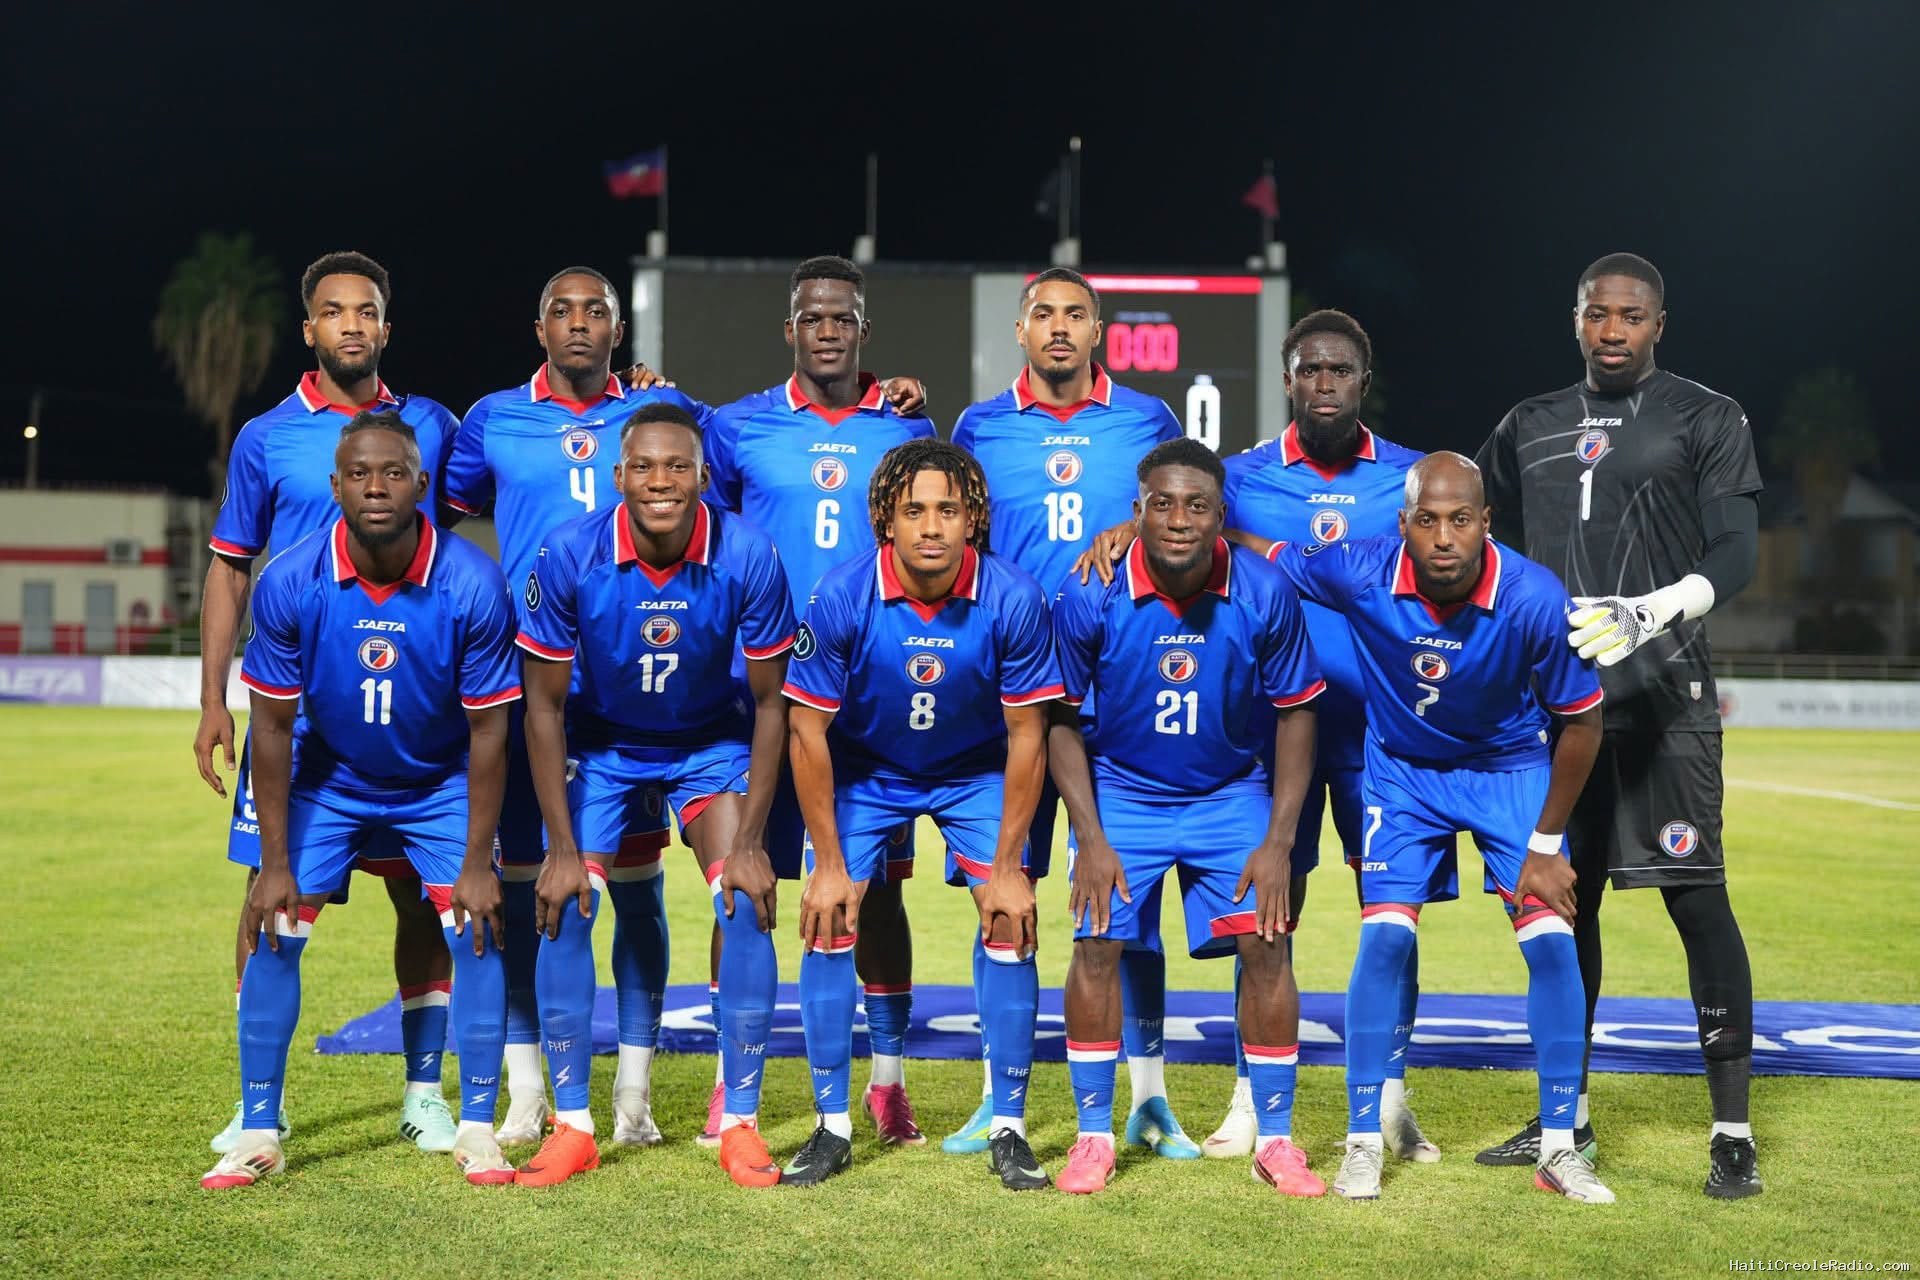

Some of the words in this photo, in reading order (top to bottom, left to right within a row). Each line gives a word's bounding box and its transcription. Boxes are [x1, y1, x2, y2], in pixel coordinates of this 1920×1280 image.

[1576, 418, 1623, 427] SAETA
[1040, 436, 1090, 446] SAETA
[808, 443, 857, 454] SAETA
[569, 467, 596, 512] 4
[1579, 469, 1593, 520] 1
[1305, 494, 1356, 504] SAETA
[1043, 492, 1083, 542] 18
[815, 498, 840, 549] 6
[635, 600, 688, 610] SAETA
[352, 620, 406, 632] SAETA
[902, 636, 954, 649] SAETA
[1153, 635, 1206, 644] SAETA
[1408, 636, 1462, 650] SAETA
[638, 653, 679, 693] 17
[360, 677, 392, 725] 11
[1416, 682, 1440, 716] 7
[908, 692, 935, 730] 8
[1155, 690, 1198, 735] 21
[1364, 806, 1382, 857] 7
[1700, 1007, 1727, 1016] FHF
[546, 1040, 570, 1052] FHF
[744, 1043, 766, 1055] FHF
[813, 1067, 832, 1076] FHF
[1007, 1067, 1029, 1077] FHF
[249, 1081, 271, 1090] FHF
[470, 1076, 496, 1085] FHF
[1356, 1085, 1377, 1095] FHF
[1553, 1085, 1575, 1095] FHF
